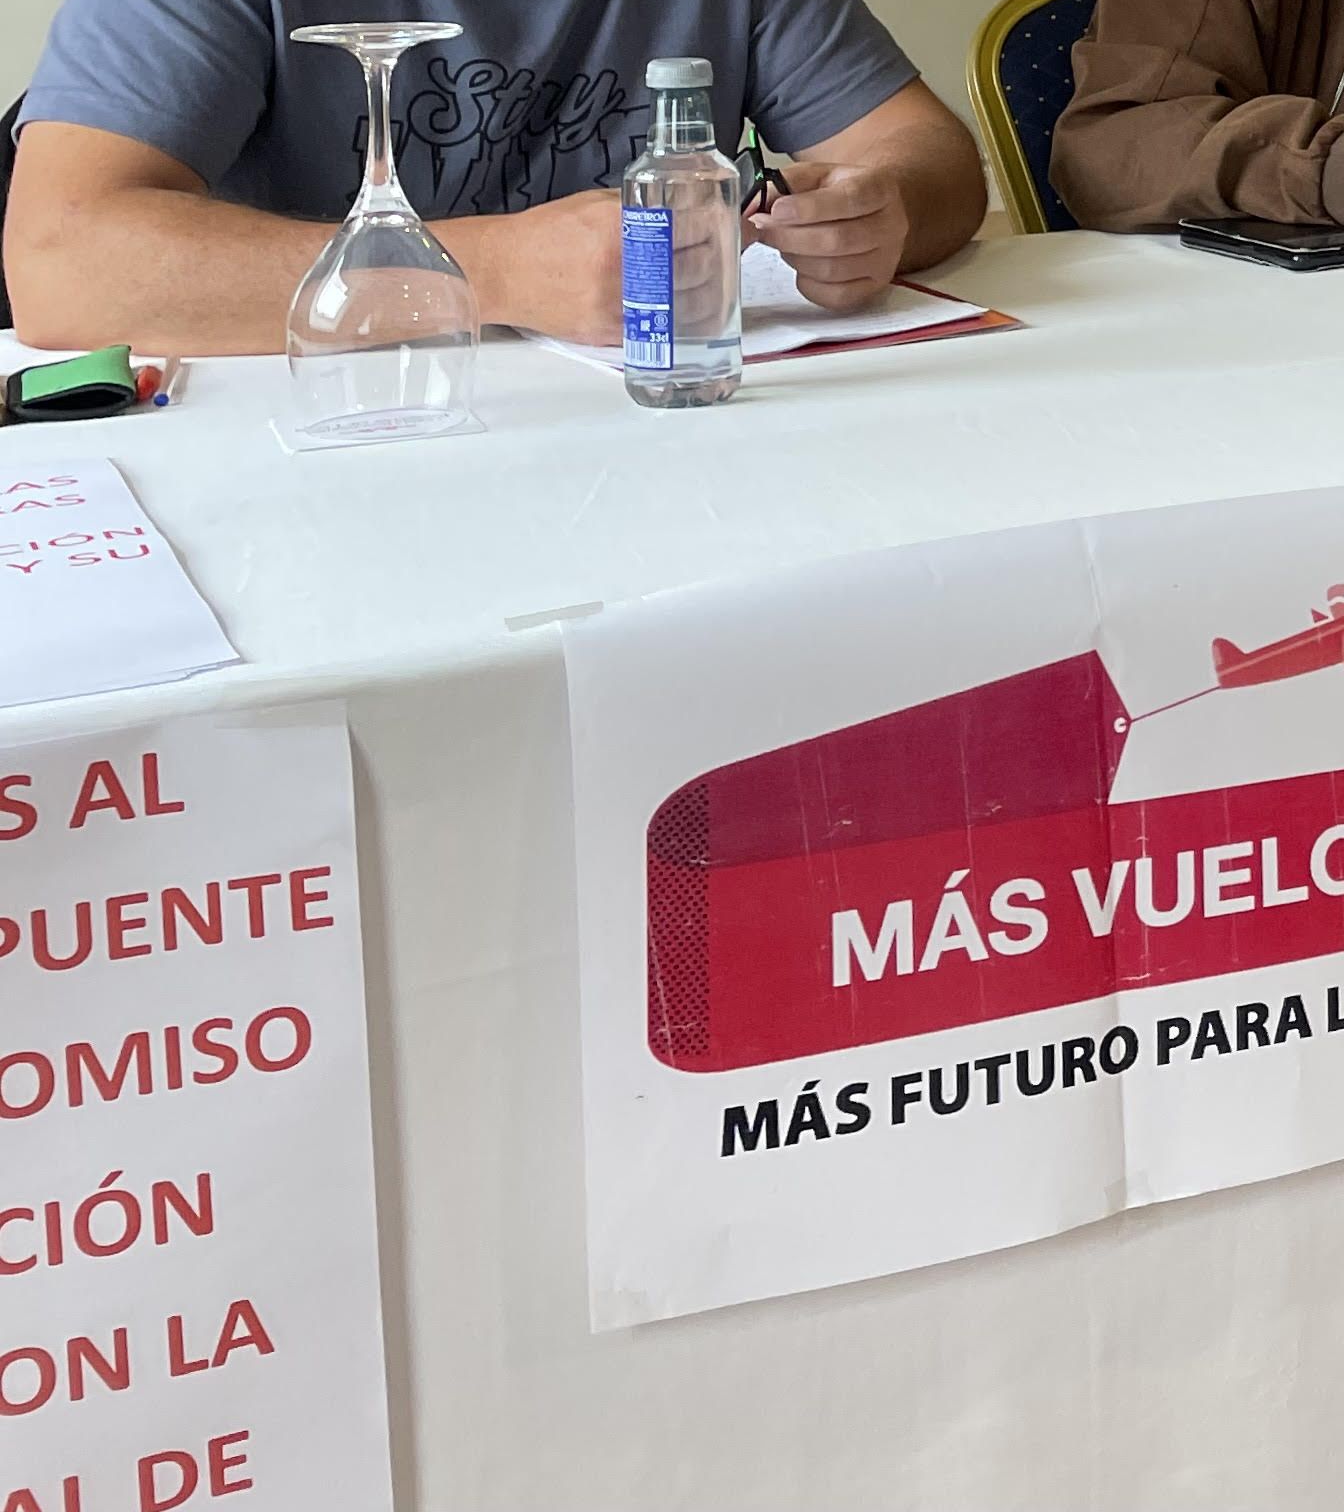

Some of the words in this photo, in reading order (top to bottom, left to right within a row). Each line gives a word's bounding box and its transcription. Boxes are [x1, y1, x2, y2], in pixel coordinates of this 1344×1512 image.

[6, 559, 43, 575] Y
[67, 544, 151, 568] SU
[68, 752, 187, 830] AL
[831, 870, 1048, 988] MÁS
[719, 1079, 874, 1158] MÁS
[888, 1025, 1140, 1129] FUTURO
[1155, 978, 1315, 1067] PARA
[167, 1298, 276, 1378] LA
[137, 1429, 254, 1512] DE
